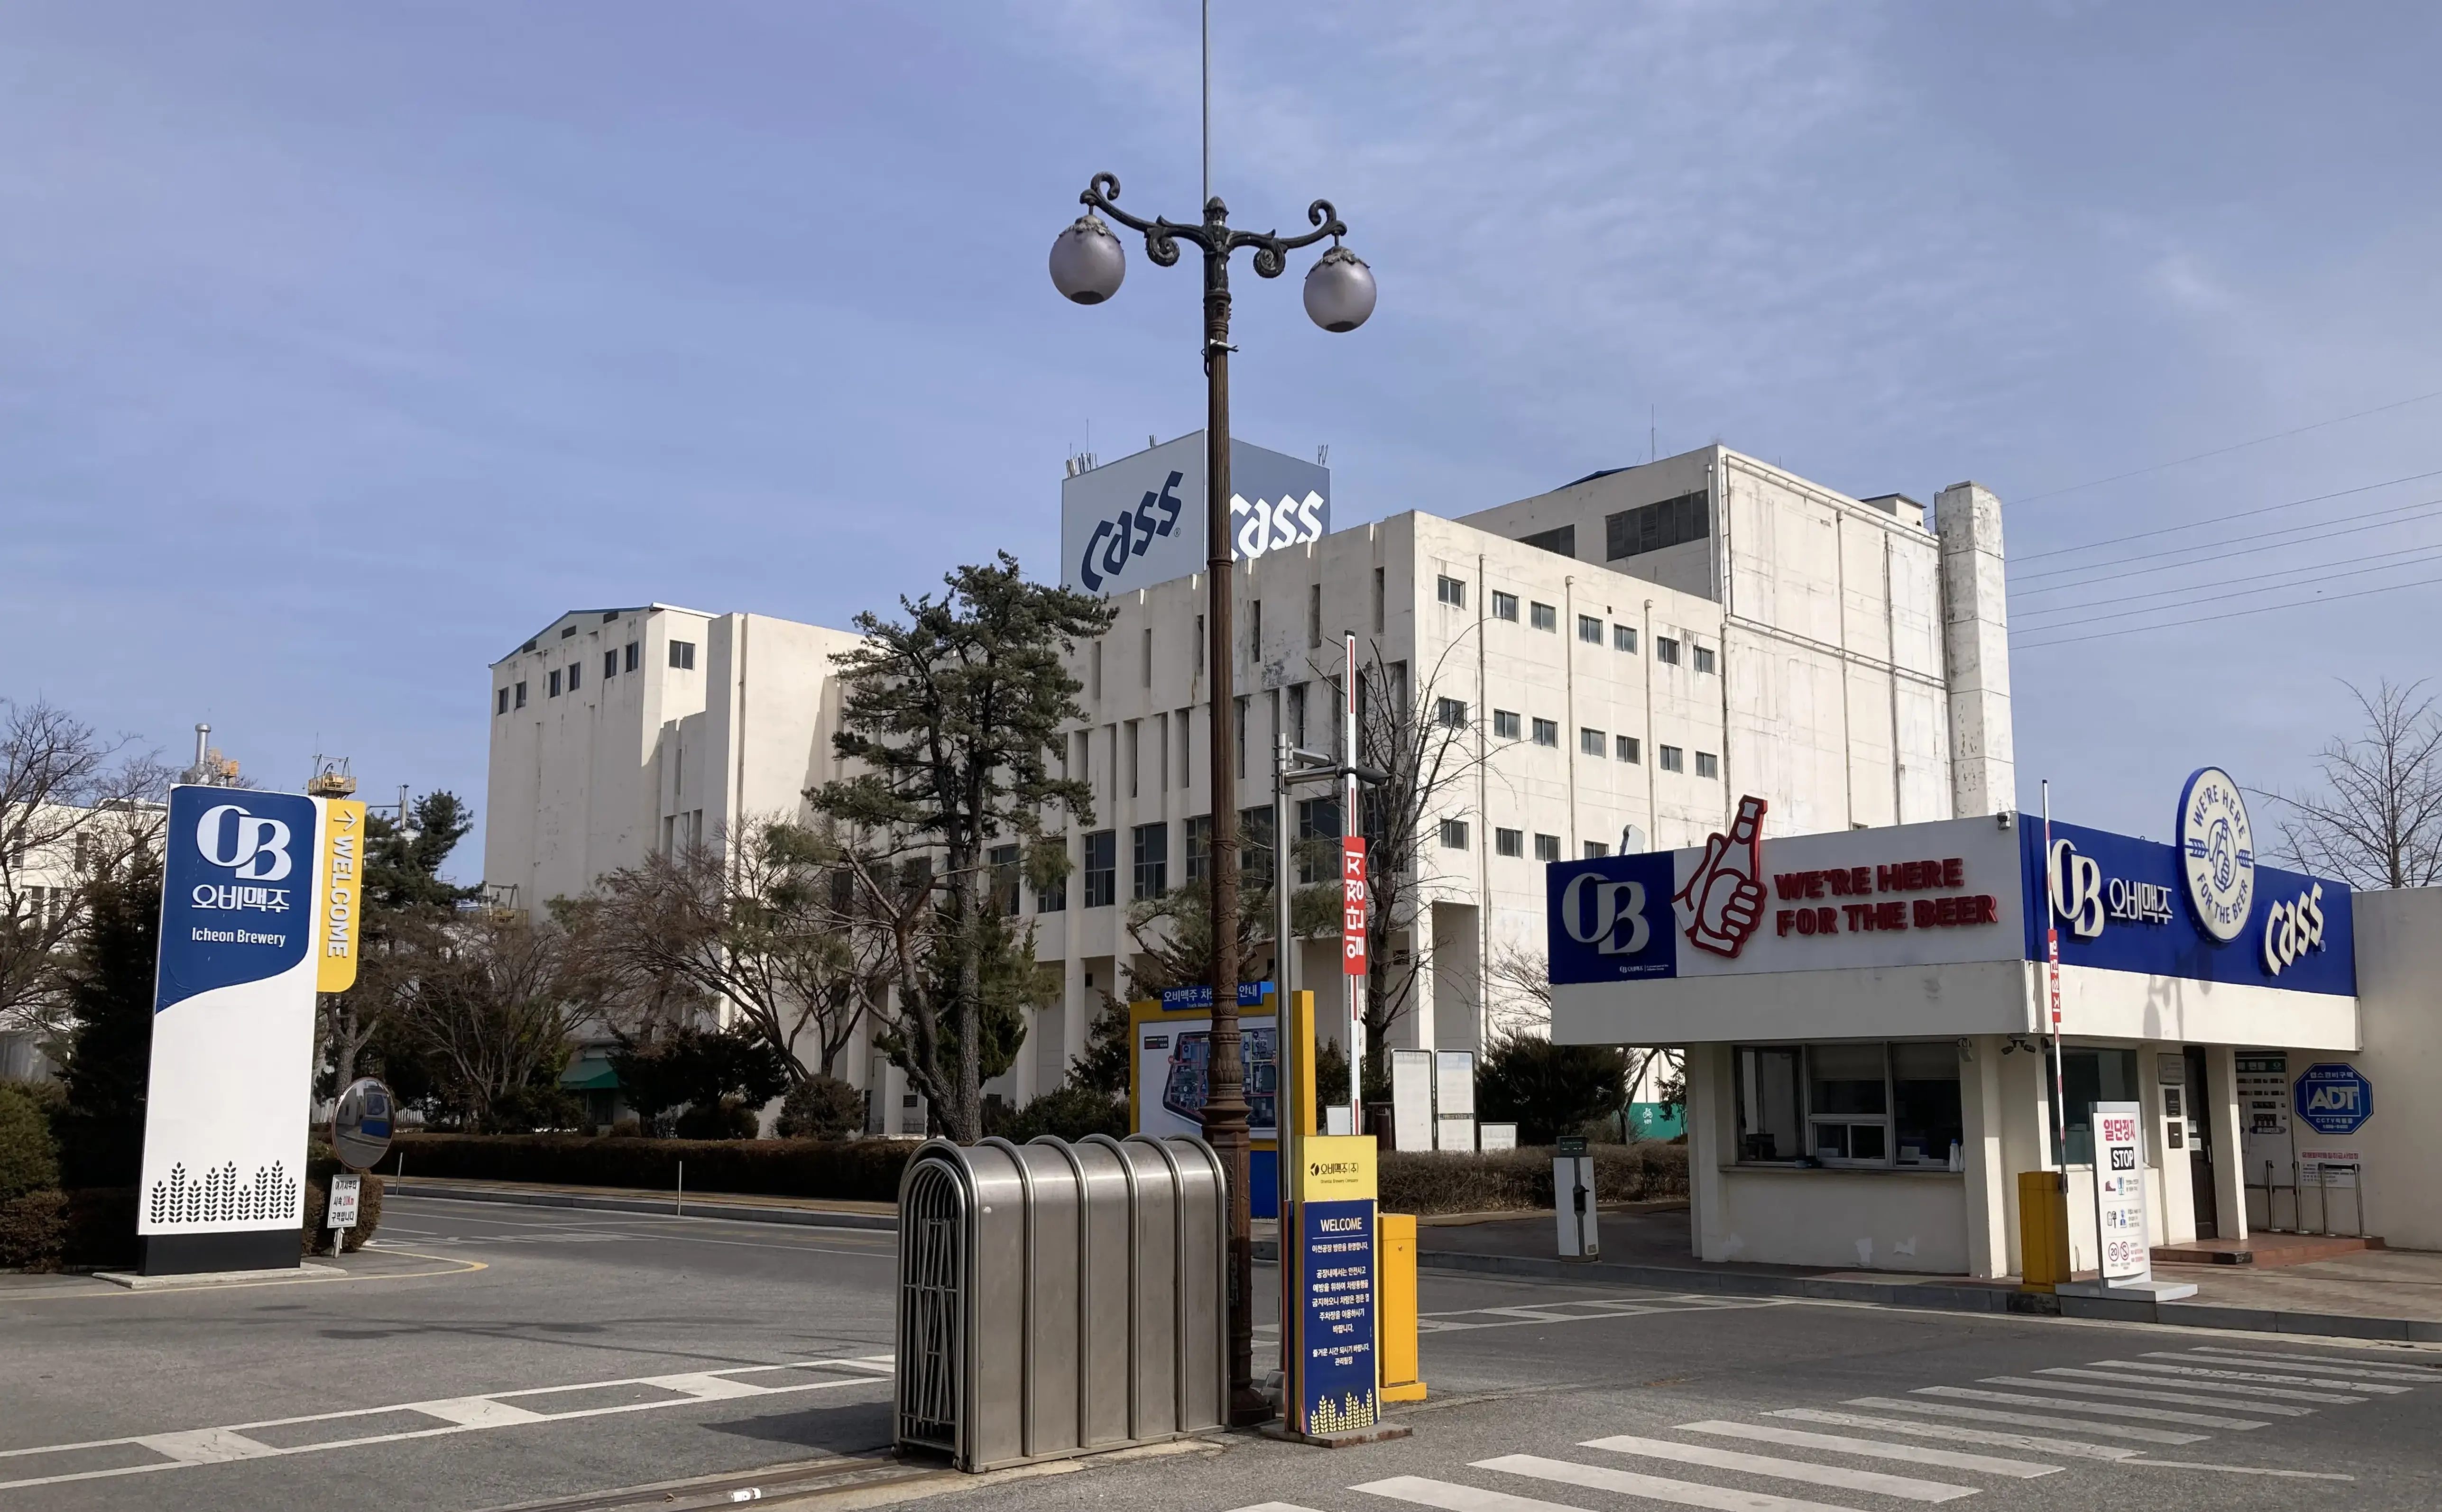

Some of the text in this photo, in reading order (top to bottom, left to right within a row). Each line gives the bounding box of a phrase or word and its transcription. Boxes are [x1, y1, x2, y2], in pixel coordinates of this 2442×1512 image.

[2193, 785, 2246, 839] WE'RE HERE
[196, 805, 292, 881] OB
[1774, 858, 1964, 900] WE'RE HERE
[2051, 839, 2104, 937] OB
[191, 884, 290, 912] 오비맥주
[327, 835, 354, 957] WELCOME
[1346, 851, 1364, 958] 일단정지
[2110, 878, 2173, 925] 오비맥주
[2197, 872, 2248, 924] FOR THE BEER
[1562, 872, 1650, 954] OB
[1777, 895, 1998, 936] FOR THE BEER
[192, 927, 286, 947] Icheon Brewery
[2049, 940, 2061, 1012] 일단정지
[1164, 990, 1198, 1002] 오비맥주
[1239, 985, 1257, 998] 안내
[2309, 1087, 2358, 1109] ADT
[2103, 1119, 2136, 1141] 일단정지
[2113, 1150, 2133, 1168] STOP
[335, 1180, 357, 1190] 여기서부터
[333, 1196, 342, 1206] 시속
[332, 1211, 354, 1222] 구역입니다
[1320, 1217, 1362, 1232] WELCOME
[1312, 1244, 1332, 1253] 이천공장
[1333, 1243, 1347, 1252] 방문을
[2110, 1248, 2118, 1256] 20
[1317, 1266, 1366, 1279] 공장내에서는 안전사고
[1313, 1283, 1329, 1292] 예방을
[1331, 1282, 1346, 1291] 위하여
[1312, 1297, 1339, 1307] 금지하오니
[1340, 1295, 1355, 1304] 차량은
[1355, 1294, 1364, 1303] 정문
[1319, 1308, 1364, 1321] 주차장을 이용하시기
[1333, 1323, 1354, 1334] 바랍니다.
[1313, 1348, 1328, 1357] 즐거운
[1329, 1347, 1339, 1355] 시간
[1335, 1356, 1353, 1365] 관리팀장
